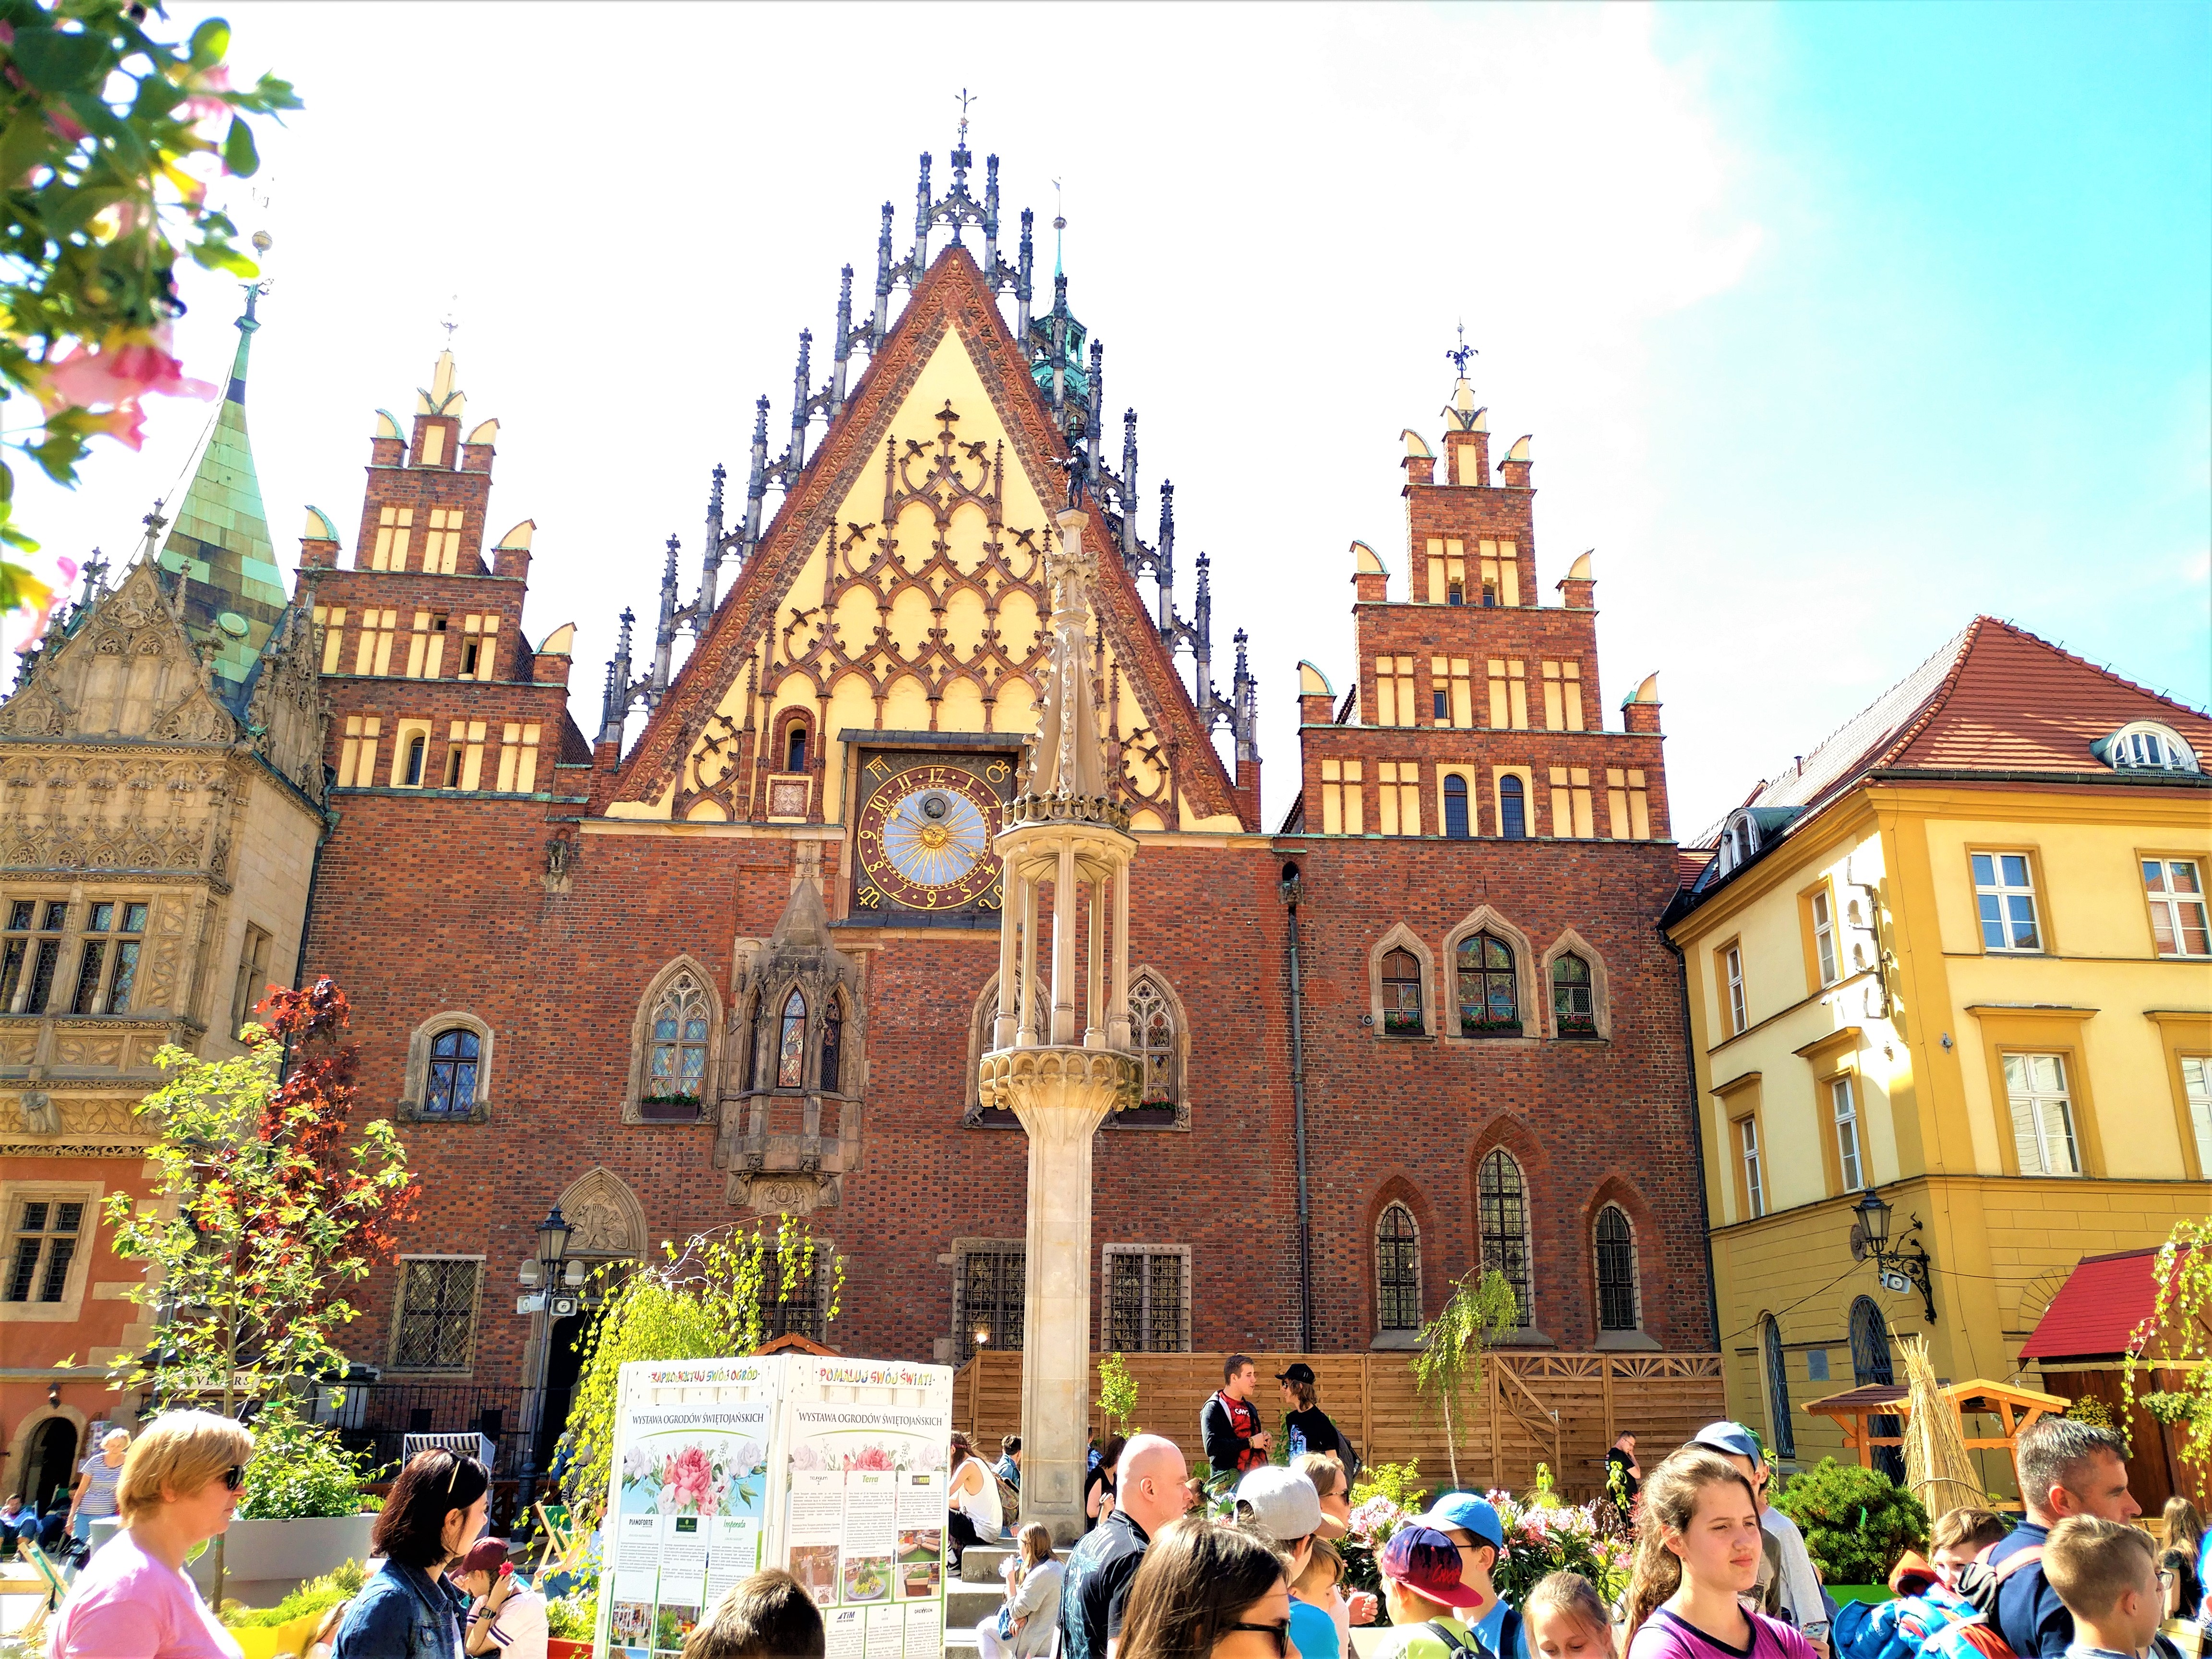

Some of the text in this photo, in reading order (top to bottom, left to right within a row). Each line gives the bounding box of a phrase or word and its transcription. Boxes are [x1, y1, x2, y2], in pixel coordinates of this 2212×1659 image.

[929, 768, 946, 782] 12
[897, 774, 912, 792] 11
[962, 777, 974, 790] 1
[870, 795, 889, 814] 10
[860, 830, 877, 840] 9
[868, 861, 883, 873] 8
[982, 865, 996, 876] 4
[891, 884, 907, 899] 7
[927, 891, 937, 908] 6
[731, 1366, 757, 1381] OGRÓD
[819, 1368, 868, 1383] POMALUJ
[633, 1412, 764, 1425] WYSTAWA OGRODÓW ŚWIĘTOJAŃSKICH
[799, 1412, 942, 1427] WYSTAWA OGRODÓW ŚWIĘTOJAŃSKICH
[862, 1475, 878, 1483] Terra
[723, 1519, 745, 1533] Imperata
